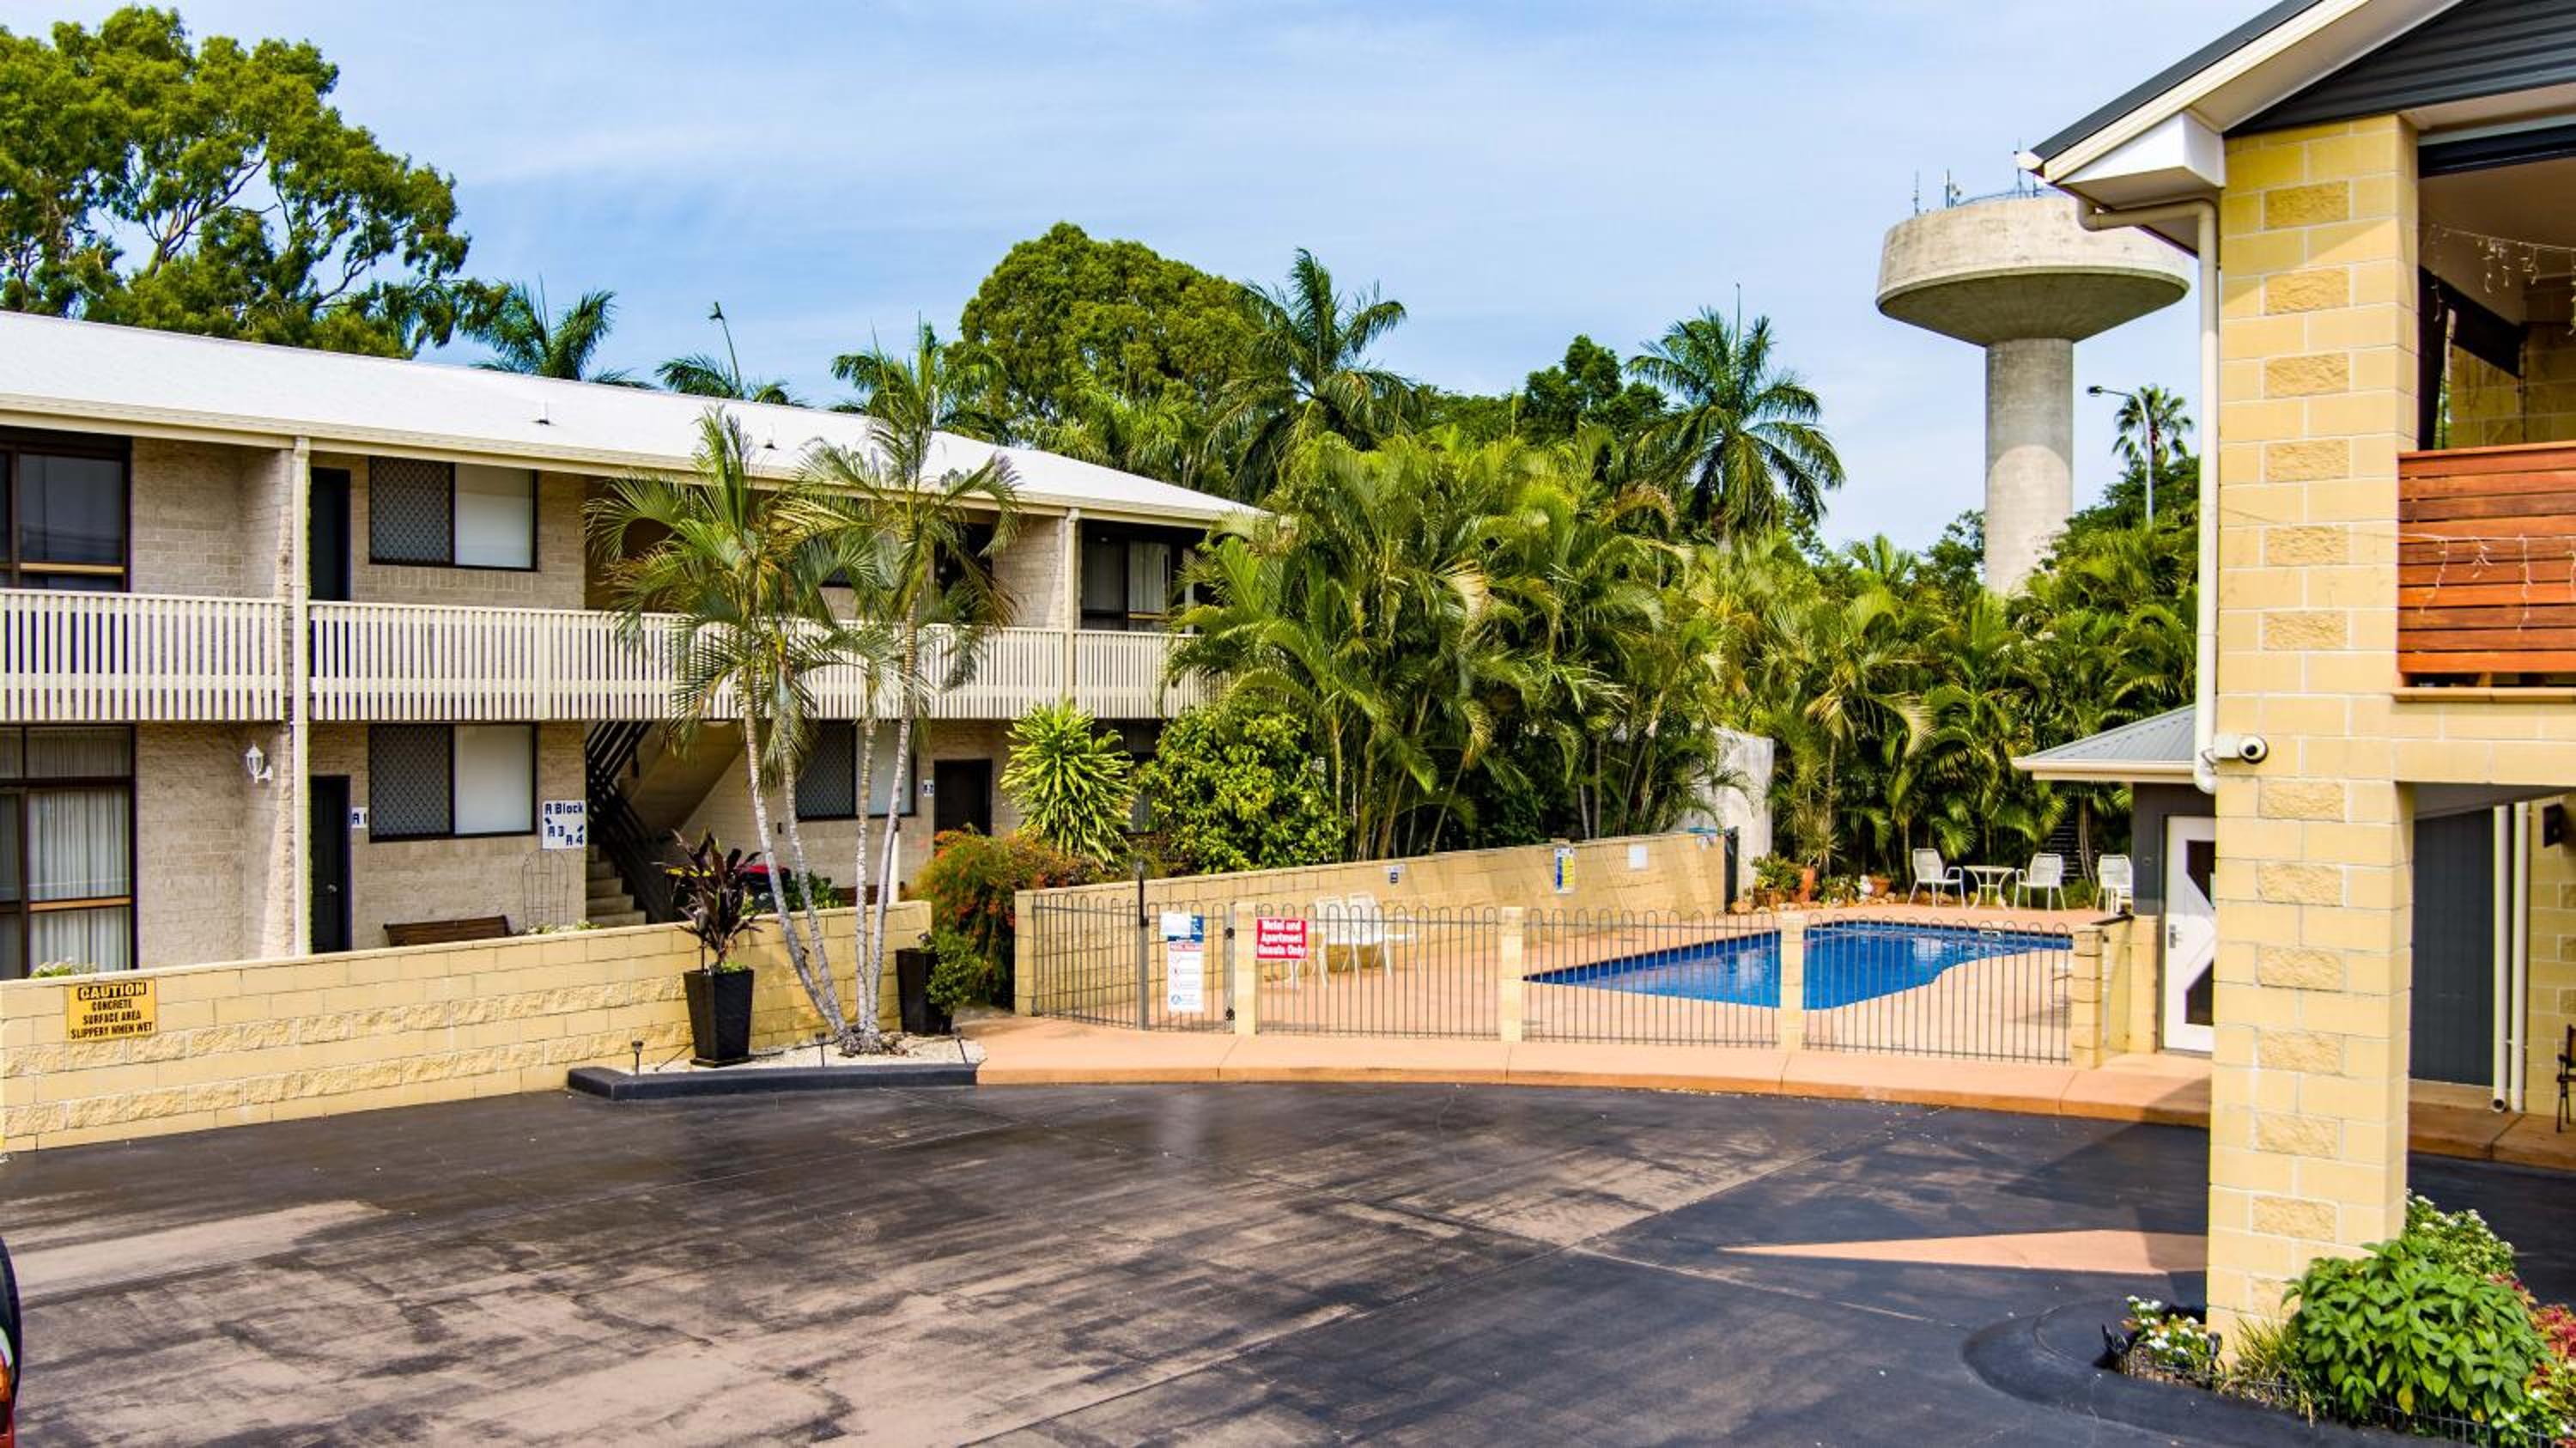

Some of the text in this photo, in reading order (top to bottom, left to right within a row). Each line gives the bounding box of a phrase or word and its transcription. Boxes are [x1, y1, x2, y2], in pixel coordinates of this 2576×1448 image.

[556, 802, 583, 814] Block
[1285, 921, 1301, 931] and
[1261, 932, 1302, 945] Apartment
[1258, 944, 1305, 957] Guests Only
[78, 982, 146, 1001] CAUTION
[92, 999, 131, 1011] CONCRETE
[82, 1010, 141, 1025] SURFACE AREA
[70, 1021, 152, 1039] SLIPPERY WHEN WET
